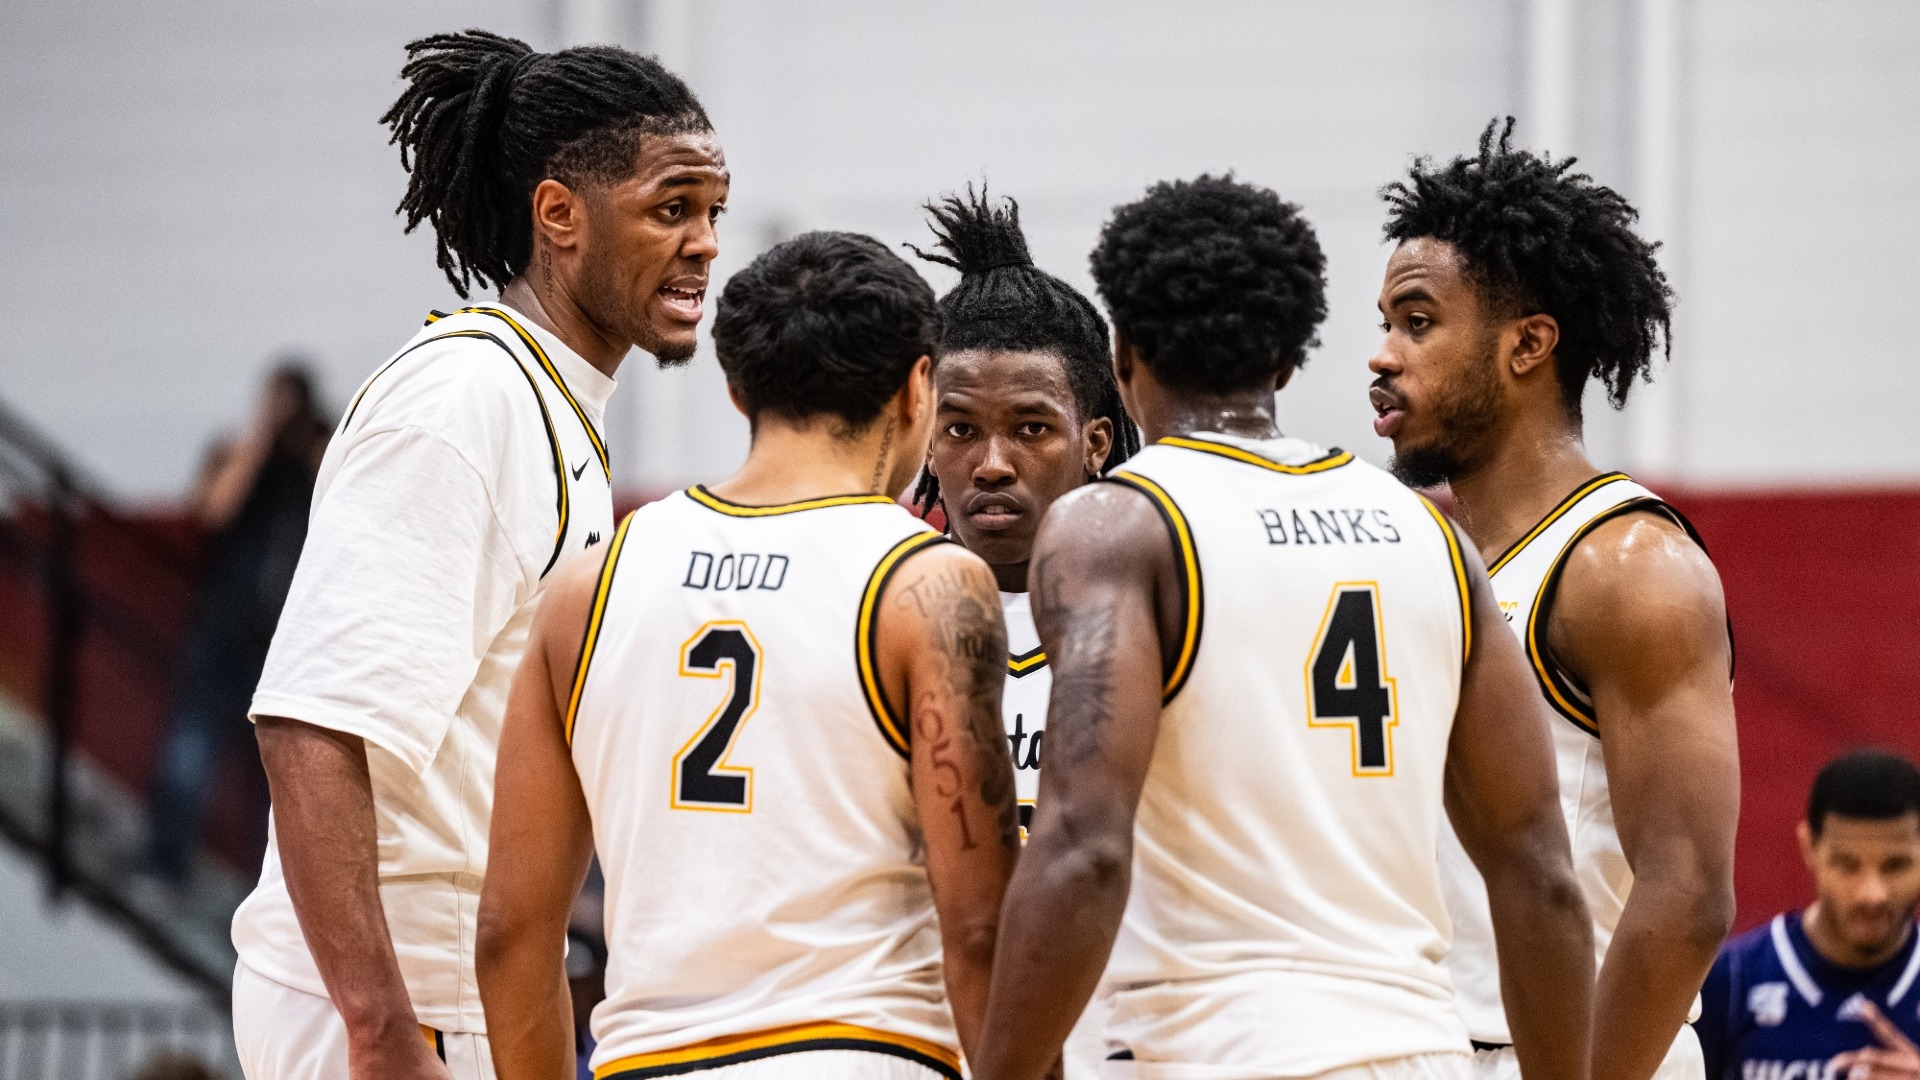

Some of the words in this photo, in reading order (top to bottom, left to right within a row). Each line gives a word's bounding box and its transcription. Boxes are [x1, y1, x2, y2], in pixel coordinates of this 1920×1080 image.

[682, 551, 790, 591] DODD
[1257, 508, 1401, 545] BANKS
[670, 620, 763, 813] 2
[1304, 580, 1399, 777] 4
